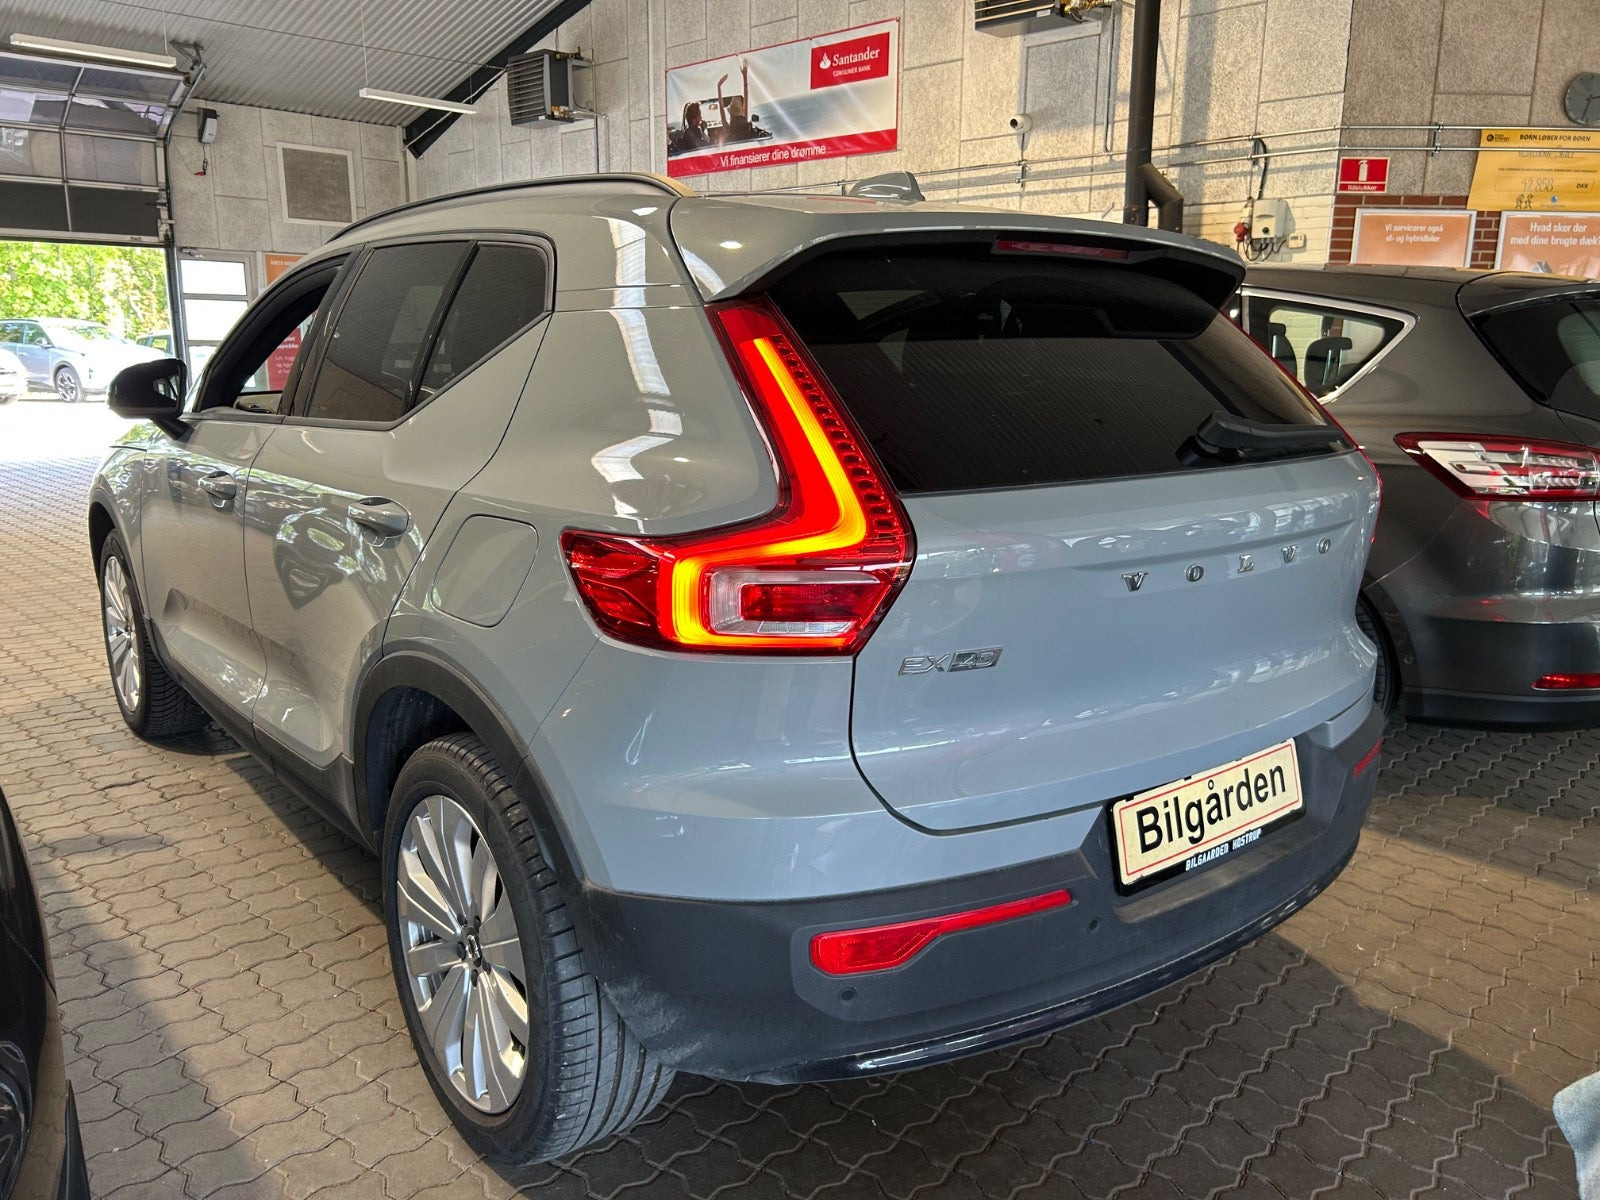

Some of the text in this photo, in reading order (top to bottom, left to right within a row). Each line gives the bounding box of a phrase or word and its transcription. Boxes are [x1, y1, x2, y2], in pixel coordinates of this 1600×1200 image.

[832, 46, 880, 67] Santander
[832, 64, 871, 78] CONSUMER BANK
[720, 145, 826, 168] Vi finansierer dine drømme
[1385, 224, 1444, 234] Vi servicerer også
[1530, 222, 1587, 232] Hvad sker der
[1396, 236, 1405, 244] og
[1510, 236, 1529, 245] med
[1531, 236, 1549, 245] dine
[1551, 236, 1577, 247] brugte
[1121, 537, 1332, 592] VOLVO
[1136, 764, 1286, 854] Bilgården
[1185, 828, 1262, 871] BILGAARDEN HOSTRUP
